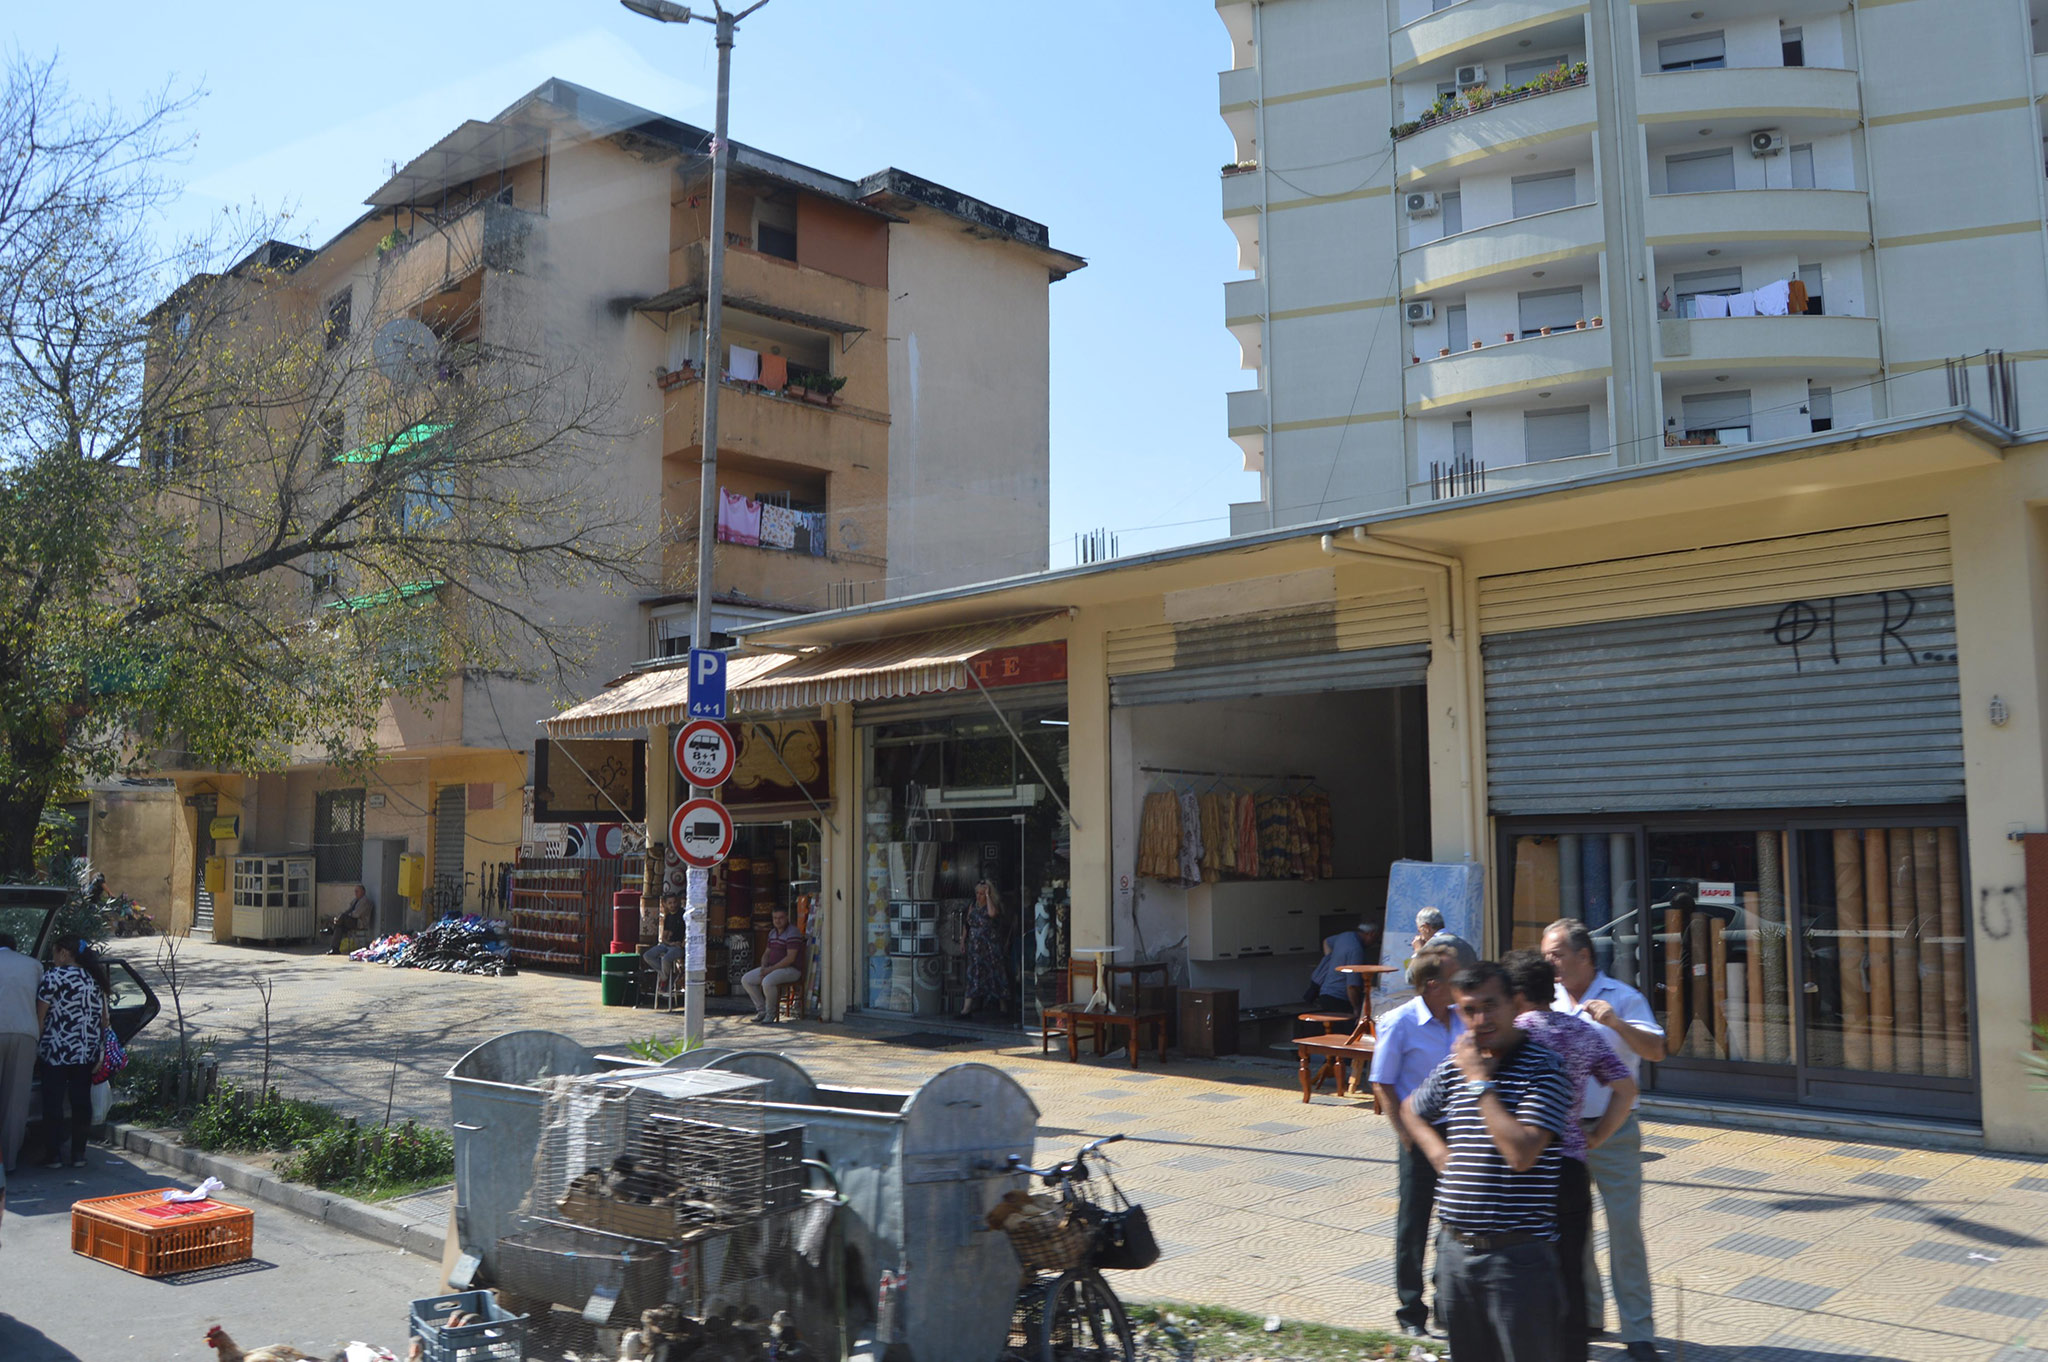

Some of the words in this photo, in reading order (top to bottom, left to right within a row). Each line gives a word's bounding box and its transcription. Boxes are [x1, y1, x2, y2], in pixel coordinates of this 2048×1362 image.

[697, 653, 719, 685] P
[693, 702, 720, 715] 4+1
[692, 751, 717, 761] 8+1
[692, 766, 717, 774] 07-22
